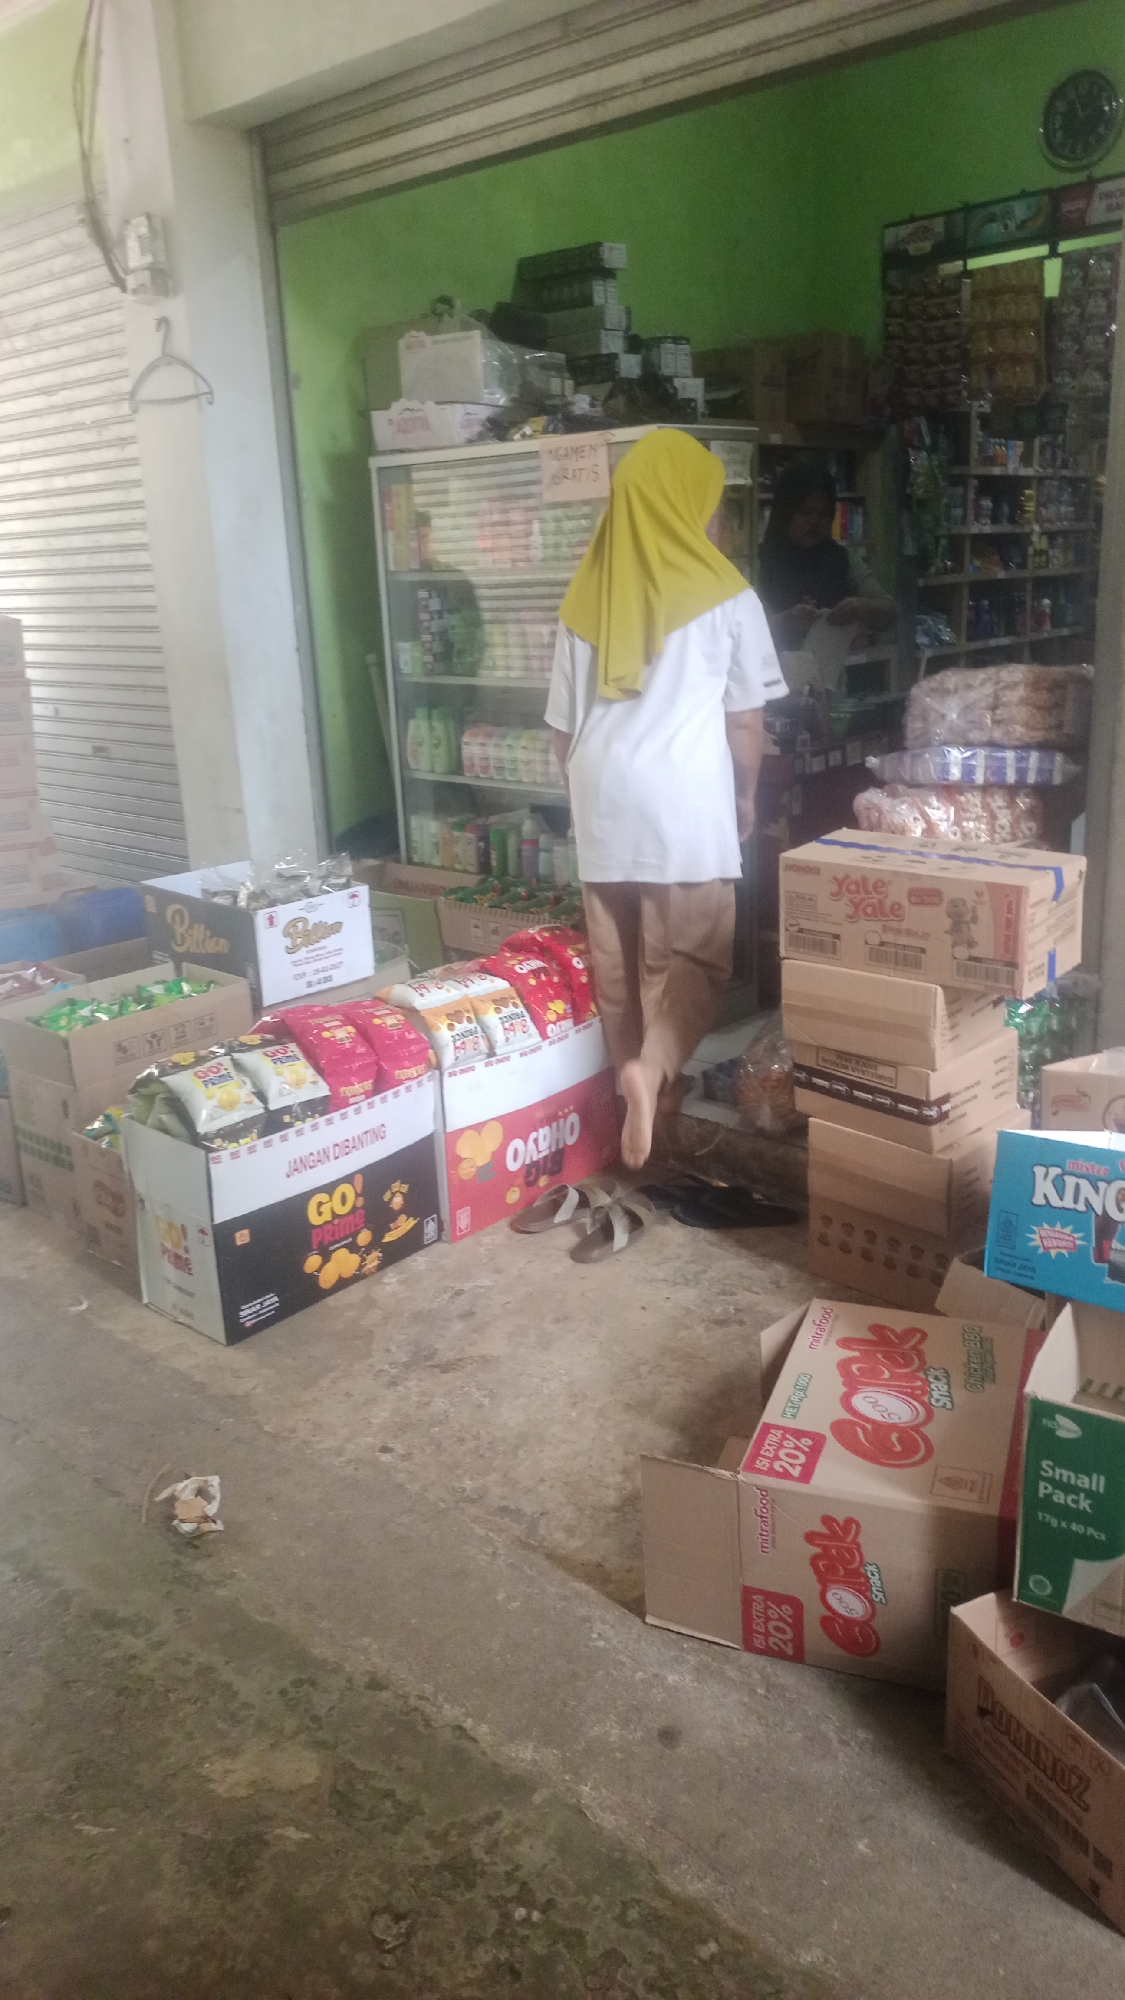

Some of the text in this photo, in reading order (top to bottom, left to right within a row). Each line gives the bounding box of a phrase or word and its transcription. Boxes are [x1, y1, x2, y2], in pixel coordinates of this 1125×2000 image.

[553, 464, 599, 485] GRATIS
[166, 903, 230, 954] Billion
[283, 916, 343, 954] Billion
[285, 1145, 331, 1178] JANGAN
[333, 1123, 387, 1161] DIBANTING
[1066, 1158, 1110, 1177] mister
[307, 1174, 364, 1226] GO!
[808, 1306, 835, 1351] mitrafood
[962, 1324, 985, 1392] Chicken BBQ
[862, 1395, 902, 1422] 500
[755, 1429, 784, 1472] ISI EXTRA
[772, 1433, 813, 1479] 20%
[1038, 1480, 1093, 1513] Pack
[1039, 1459, 1106, 1493] Small
[753, 1487, 770, 1554] mitrafood
[752, 1594, 766, 1649] ISI EXTRA
[832, 1591, 860, 1616] 500
[768, 1600, 793, 1656] 20%
